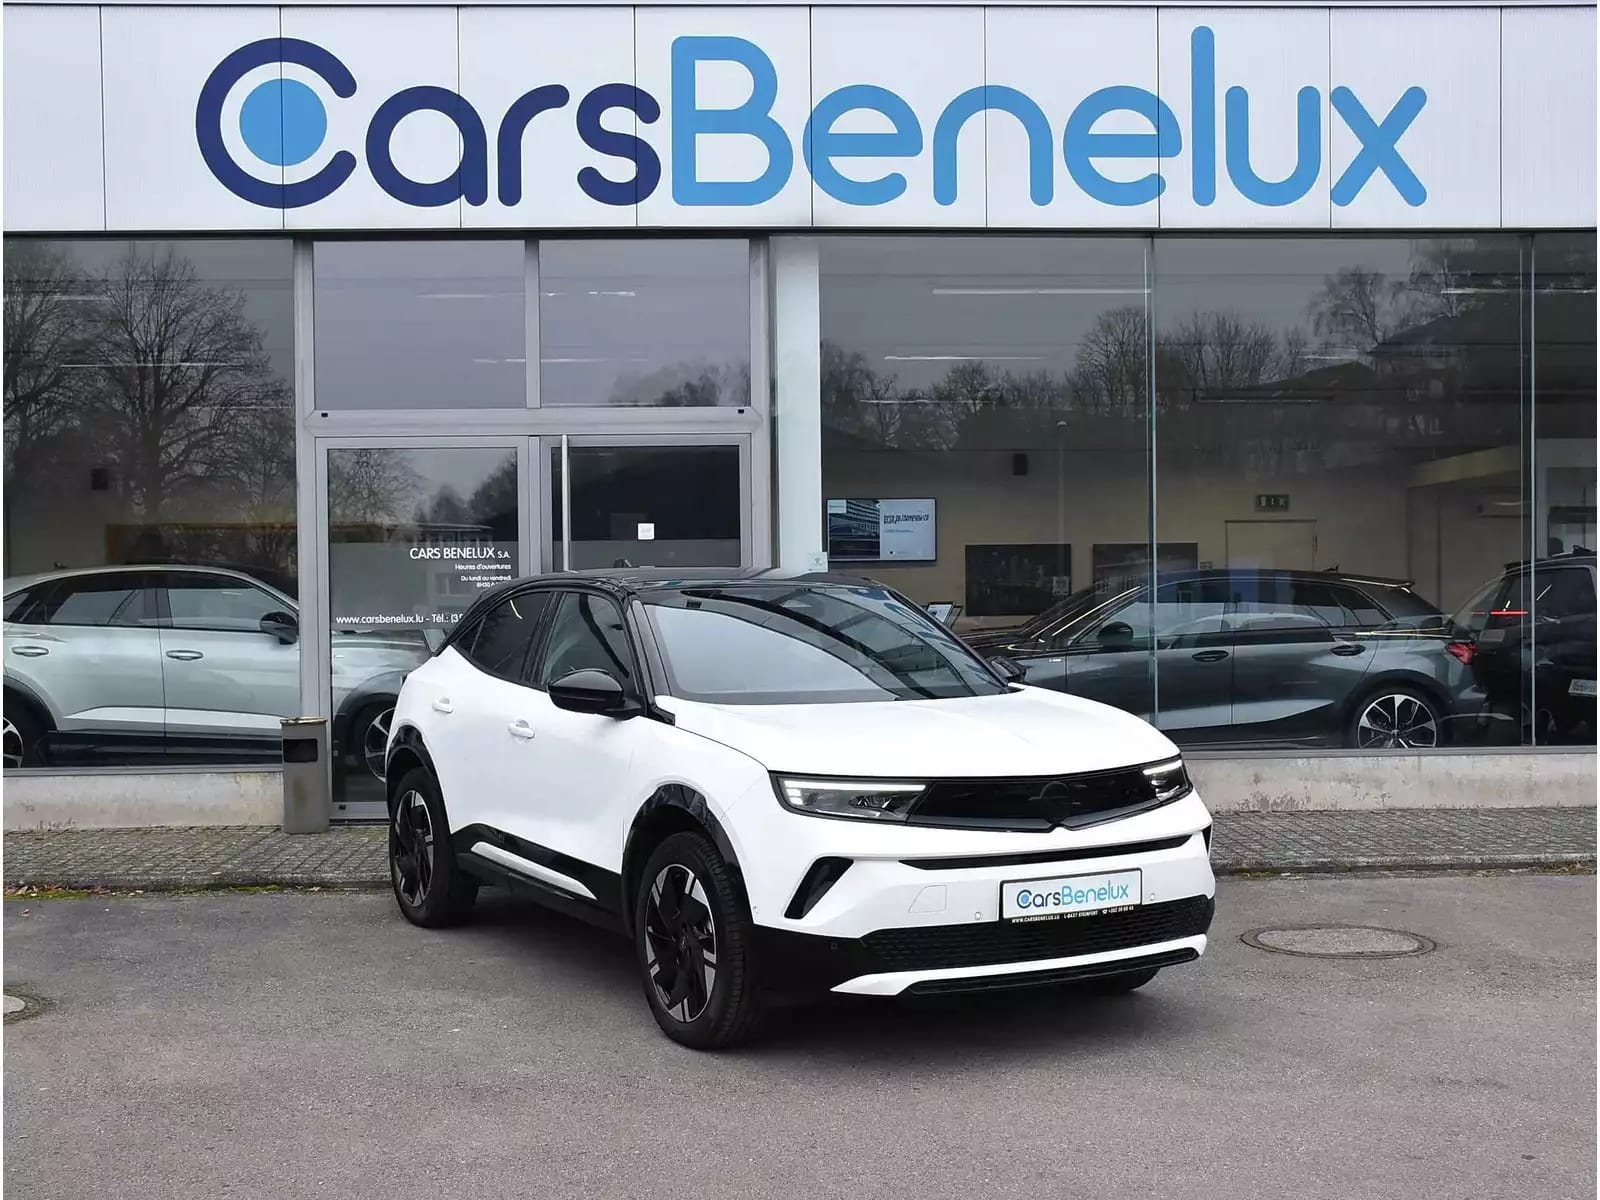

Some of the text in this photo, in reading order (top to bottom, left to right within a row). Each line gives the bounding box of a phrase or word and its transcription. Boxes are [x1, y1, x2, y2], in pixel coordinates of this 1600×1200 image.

[196, 26, 1427, 207] CarsBenelux
[410, 547, 440, 559] CARS
[443, 547, 496, 559] BENELUX
[336, 614, 424, 624] www.carsbenelux.lu
[1016, 880, 1129, 909] CarsBenelux
